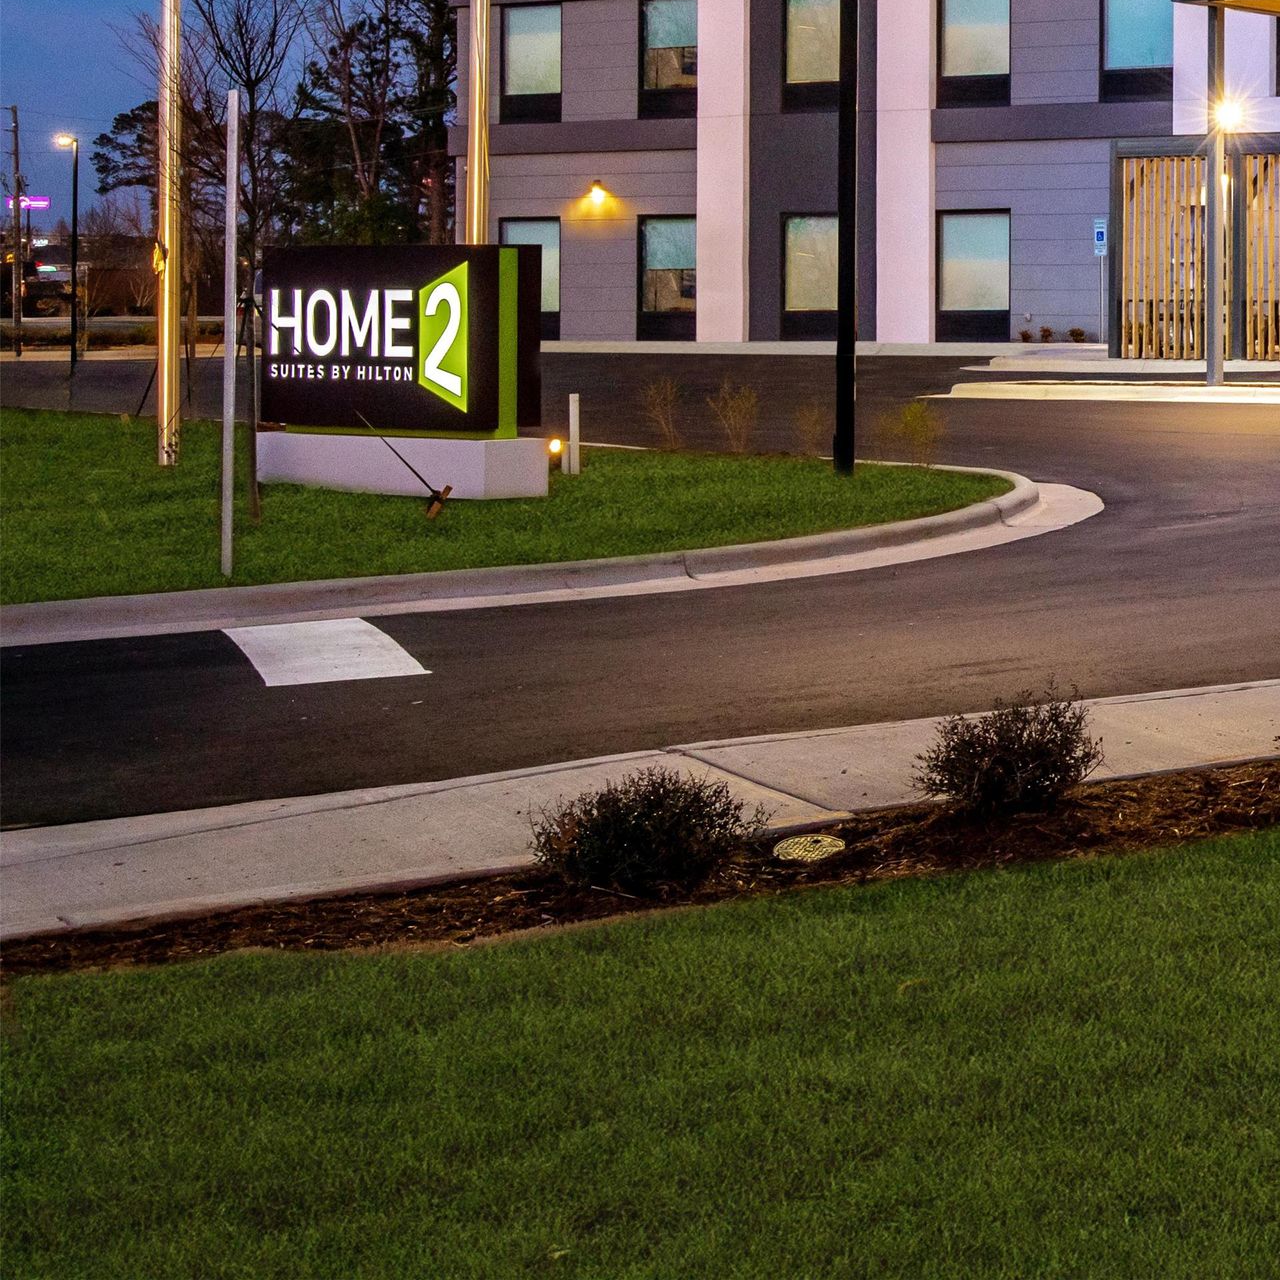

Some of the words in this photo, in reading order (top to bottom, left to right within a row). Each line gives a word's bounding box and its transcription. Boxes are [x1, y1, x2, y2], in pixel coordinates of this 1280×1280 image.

[270, 289, 414, 358] HOME
[424, 282, 462, 397] 2
[270, 363, 325, 379] SUITES
[331, 365, 350, 380] BY
[357, 365, 413, 381] HILTON
